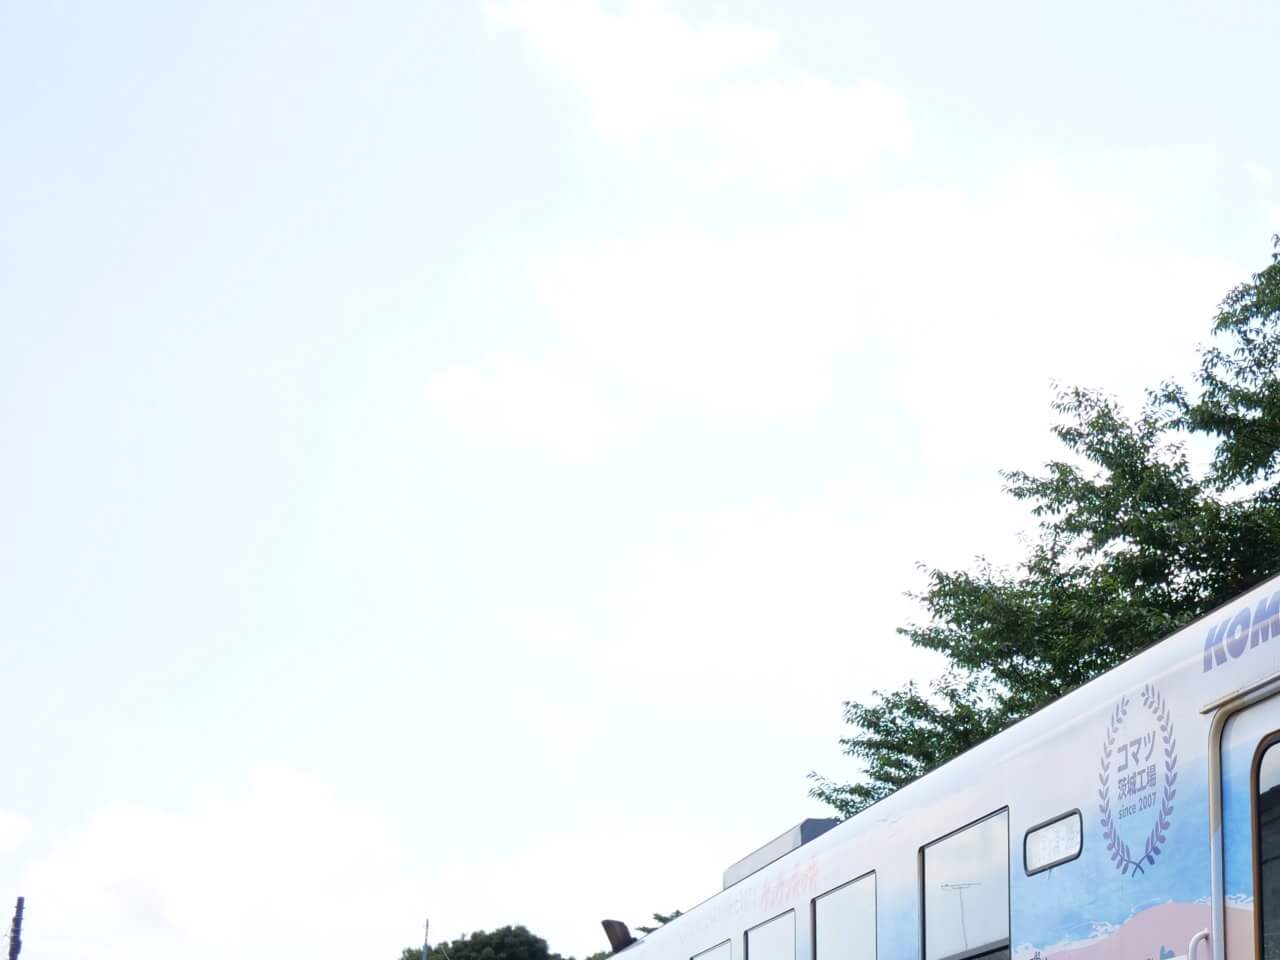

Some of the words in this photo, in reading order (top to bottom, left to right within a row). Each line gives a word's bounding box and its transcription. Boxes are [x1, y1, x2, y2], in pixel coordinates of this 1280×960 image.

[1117, 730, 1156, 773] コマツ
[1117, 764, 1157, 801] 茨城工場
[1118, 803, 1137, 820] since
[1138, 792, 1157, 812] 2007
